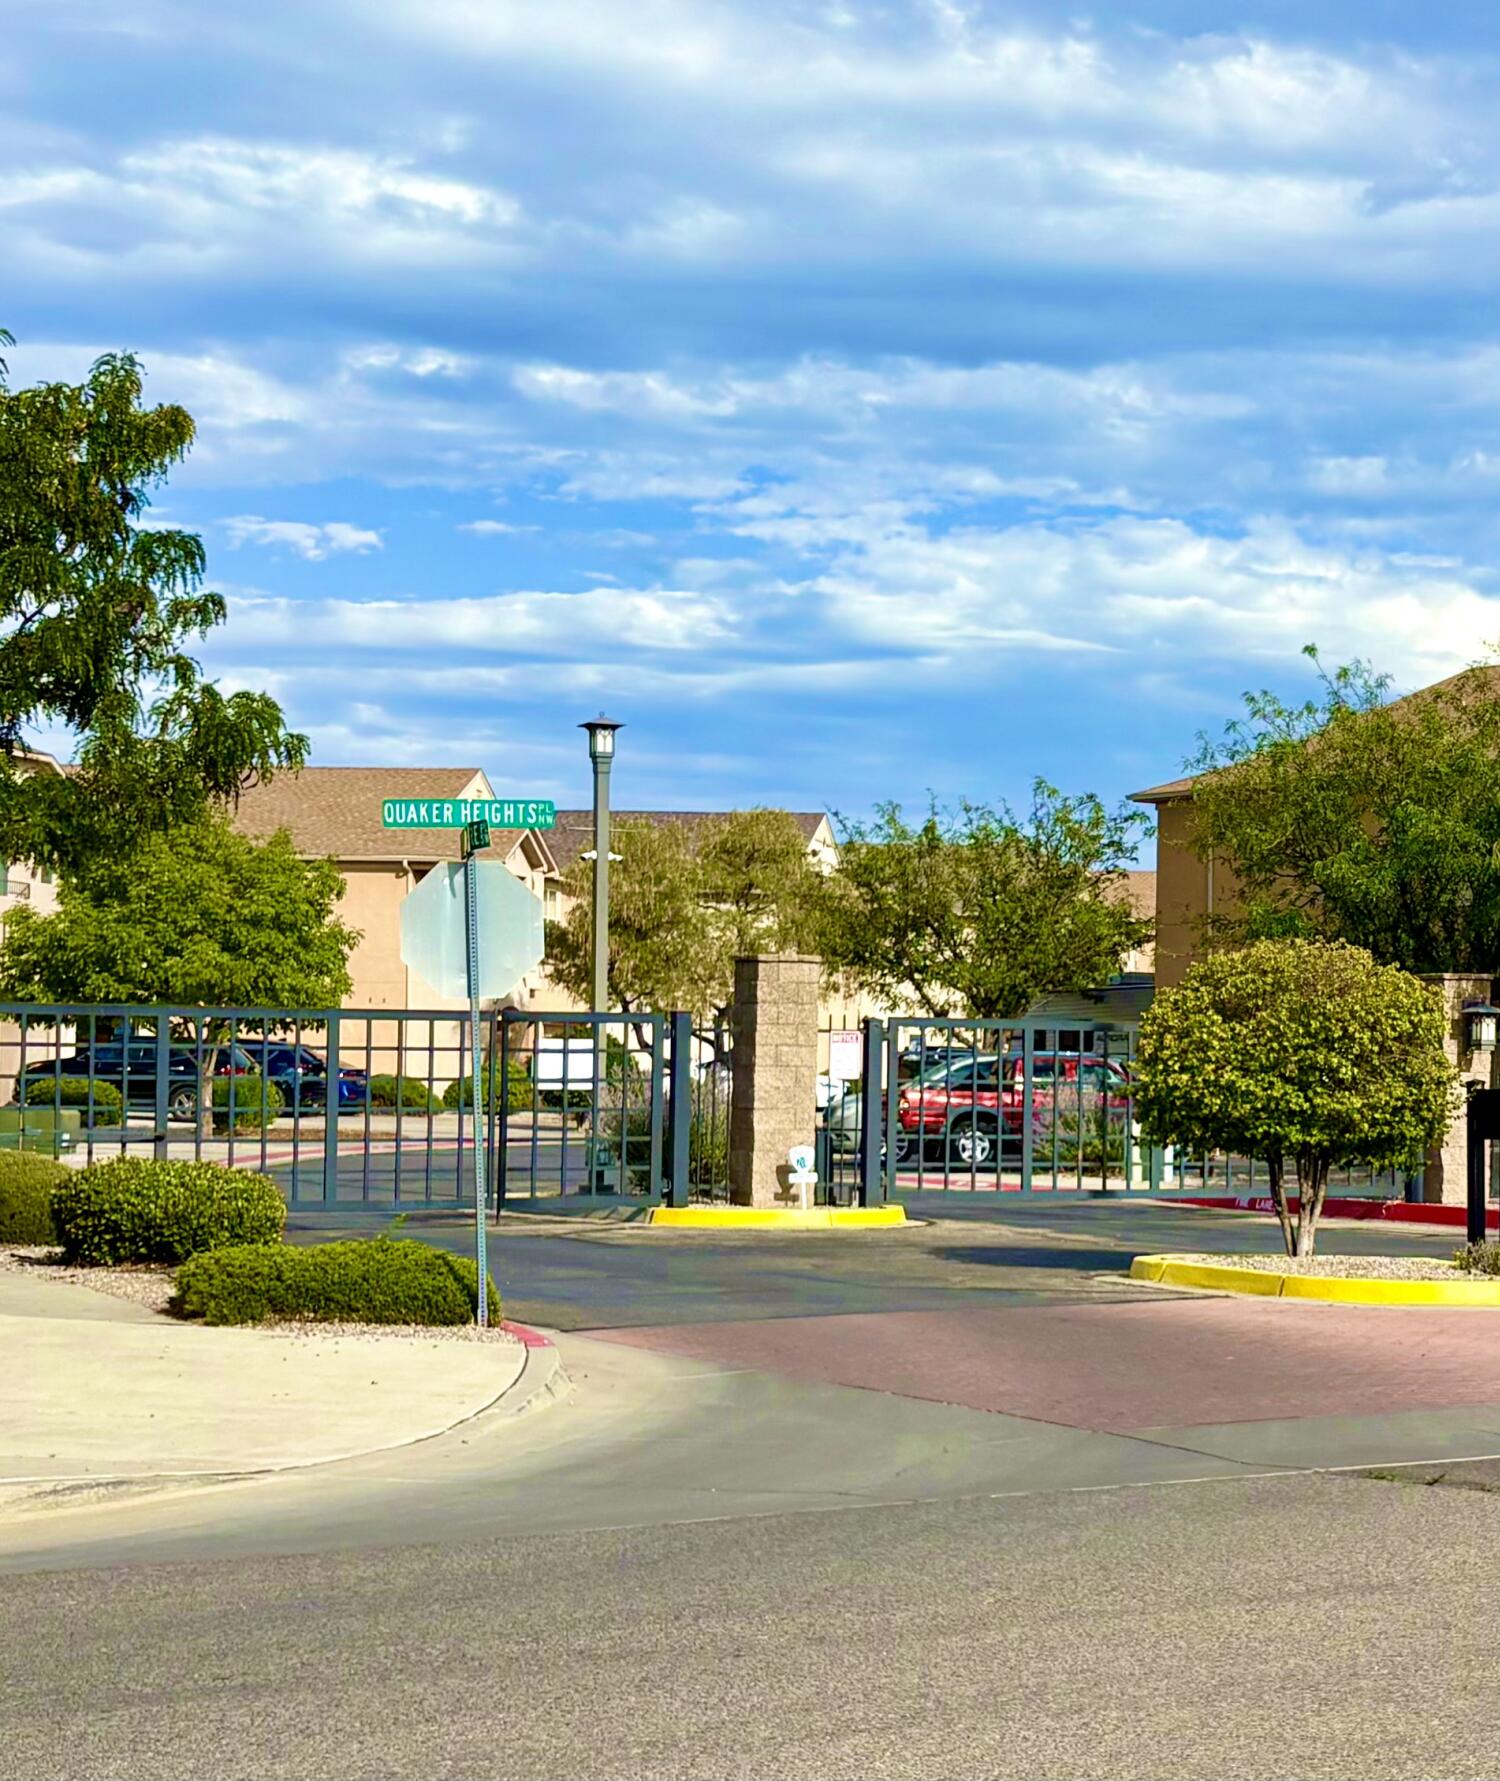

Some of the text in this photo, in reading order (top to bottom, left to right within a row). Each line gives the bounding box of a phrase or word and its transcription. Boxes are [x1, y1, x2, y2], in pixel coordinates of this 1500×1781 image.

[383, 802, 537, 824] QUAKER HEIGHTS
[538, 803, 552, 814] PL
